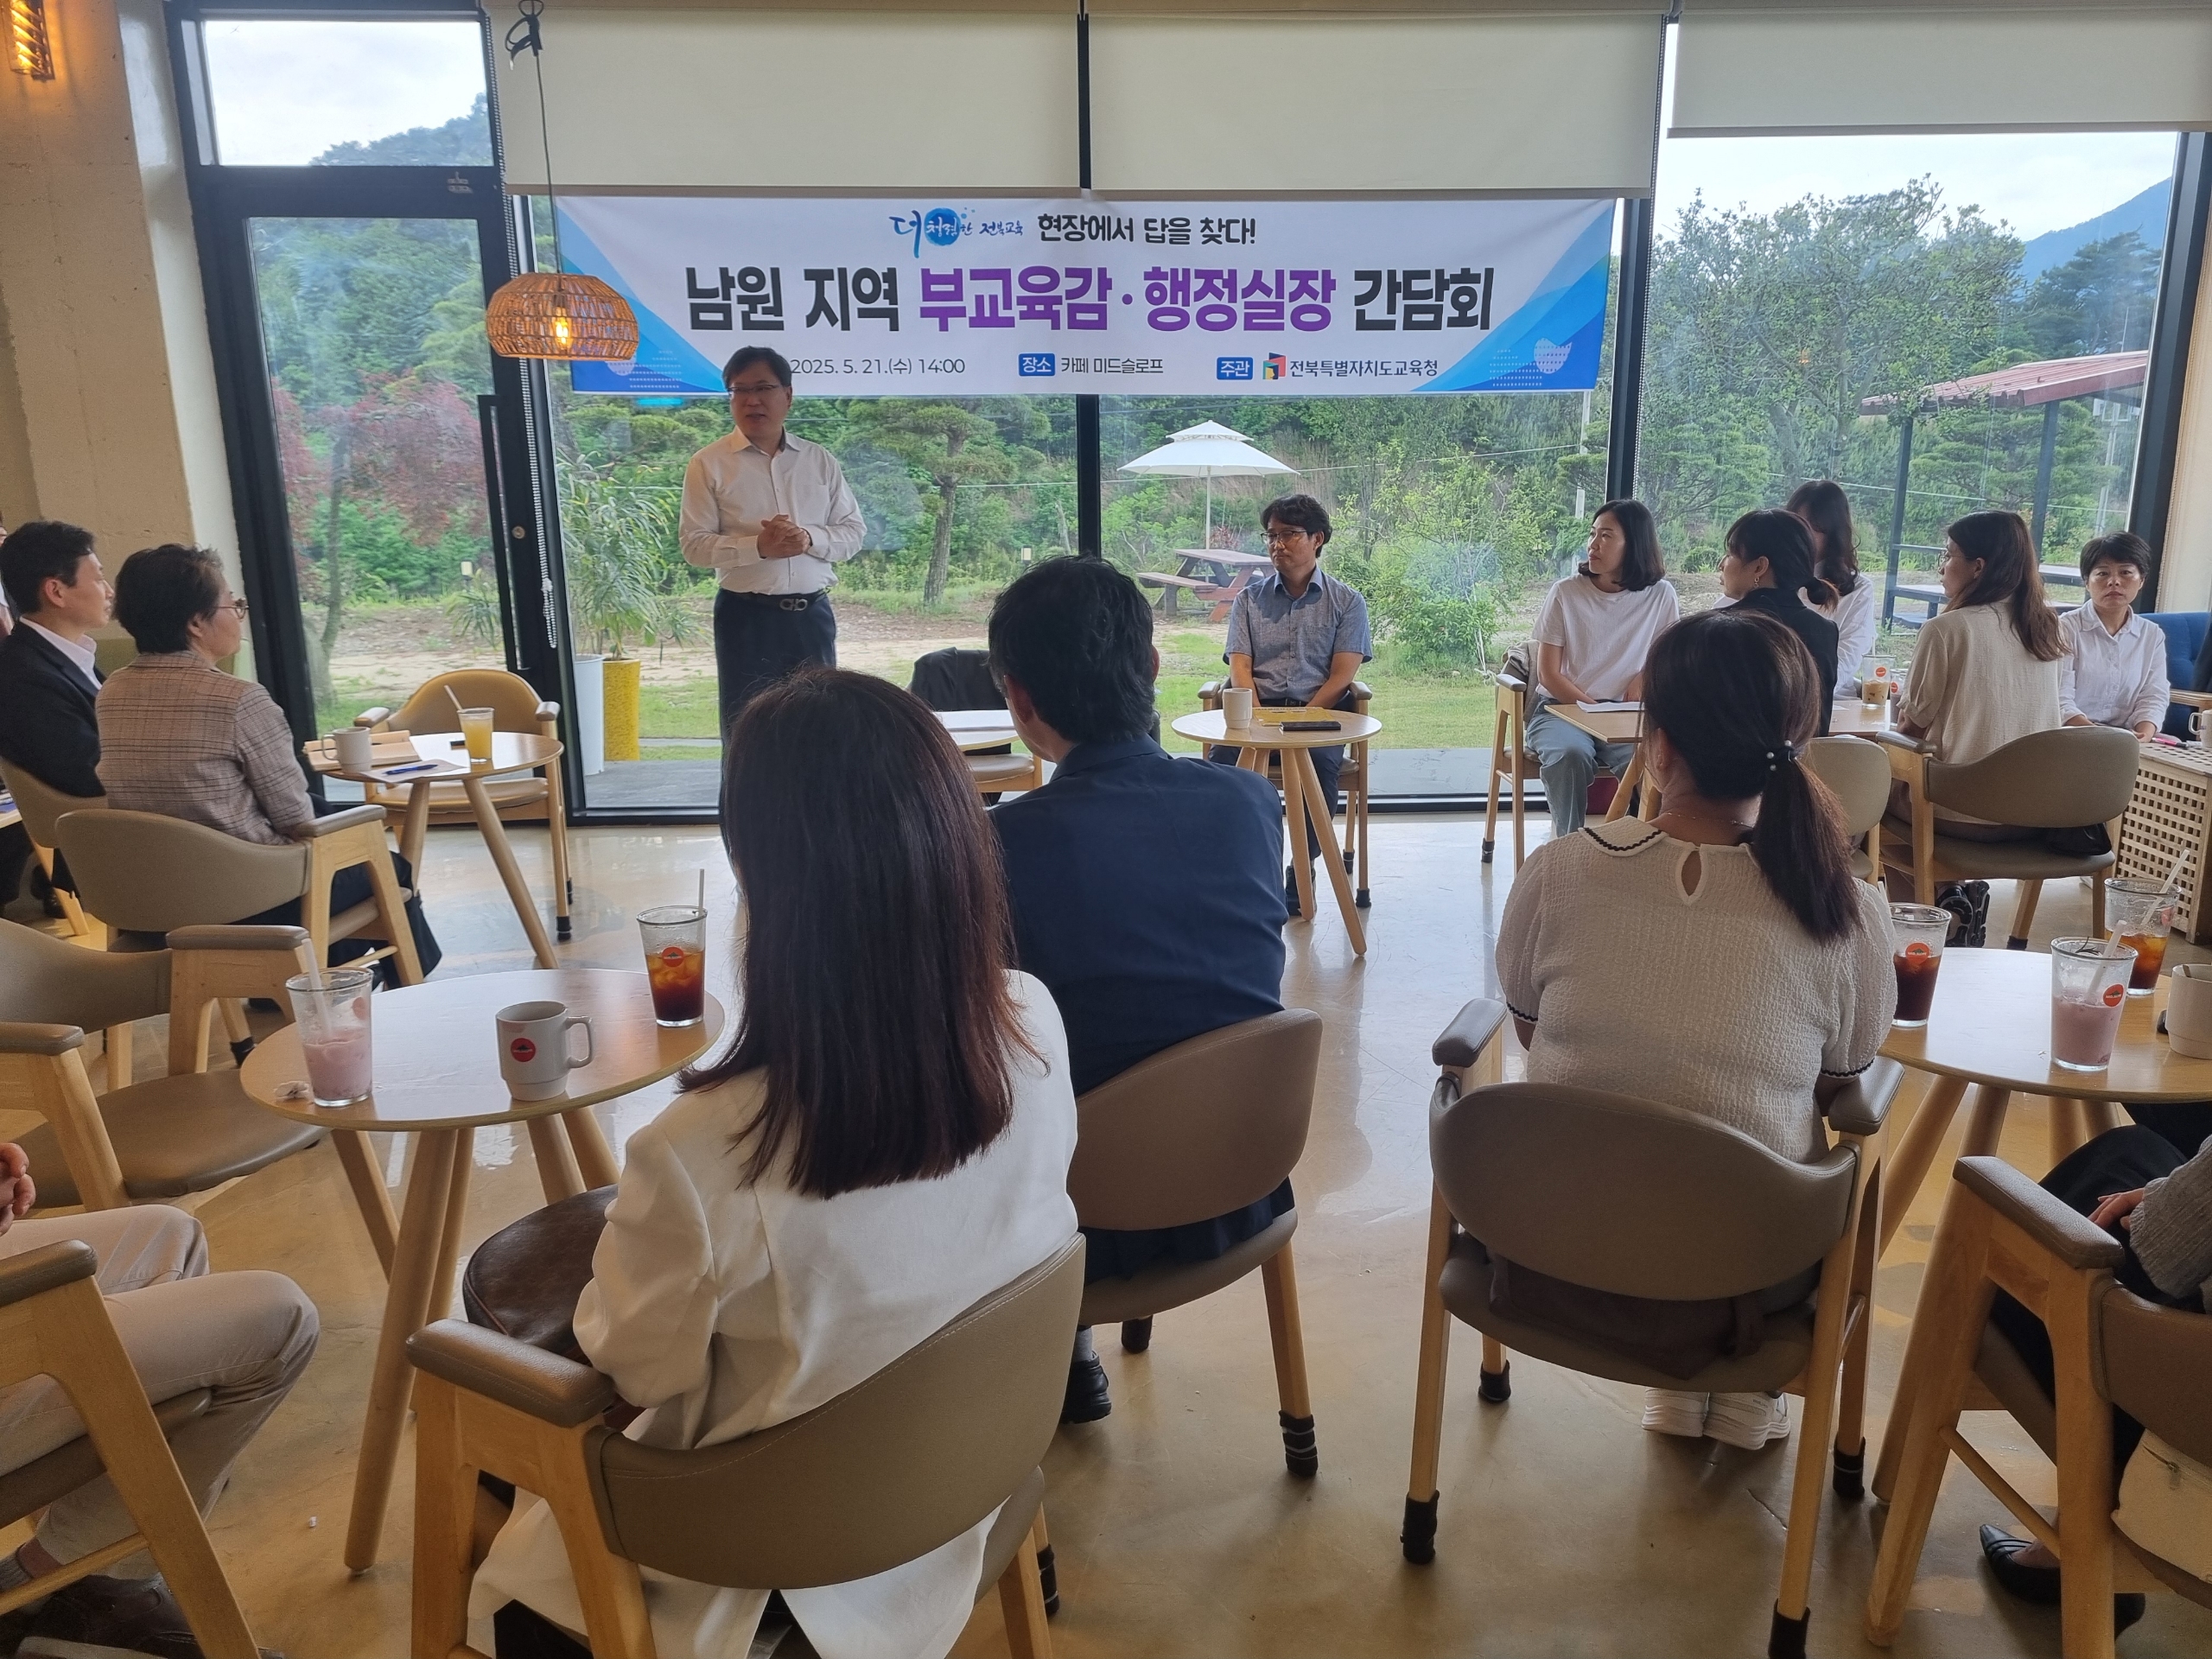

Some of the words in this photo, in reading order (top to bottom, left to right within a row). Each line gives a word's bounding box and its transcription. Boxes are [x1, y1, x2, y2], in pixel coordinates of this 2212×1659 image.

[888, 209, 922, 259] 더
[978, 219, 1024, 237] 전북교육
[1037, 213, 1134, 242] 현장에서
[1143, 217, 1192, 245] 답을
[1199, 217, 1256, 245] 찾다!
[684, 264, 785, 332] 남원
[803, 265, 899, 332] 지역
[1353, 266, 1495, 332] 간담회
[790, 358, 839, 374] 2025.
[842, 358, 858, 374] 5.
[918, 358, 966, 374] 14:00
[1022, 356, 1052, 373] 장소
[1060, 357, 1089, 374] 카페
[1093, 357, 1164, 374] 미드슬로프
[1220, 360, 1250, 378] 주관
[1289, 359, 1438, 378] 전북특별자치도교육청
